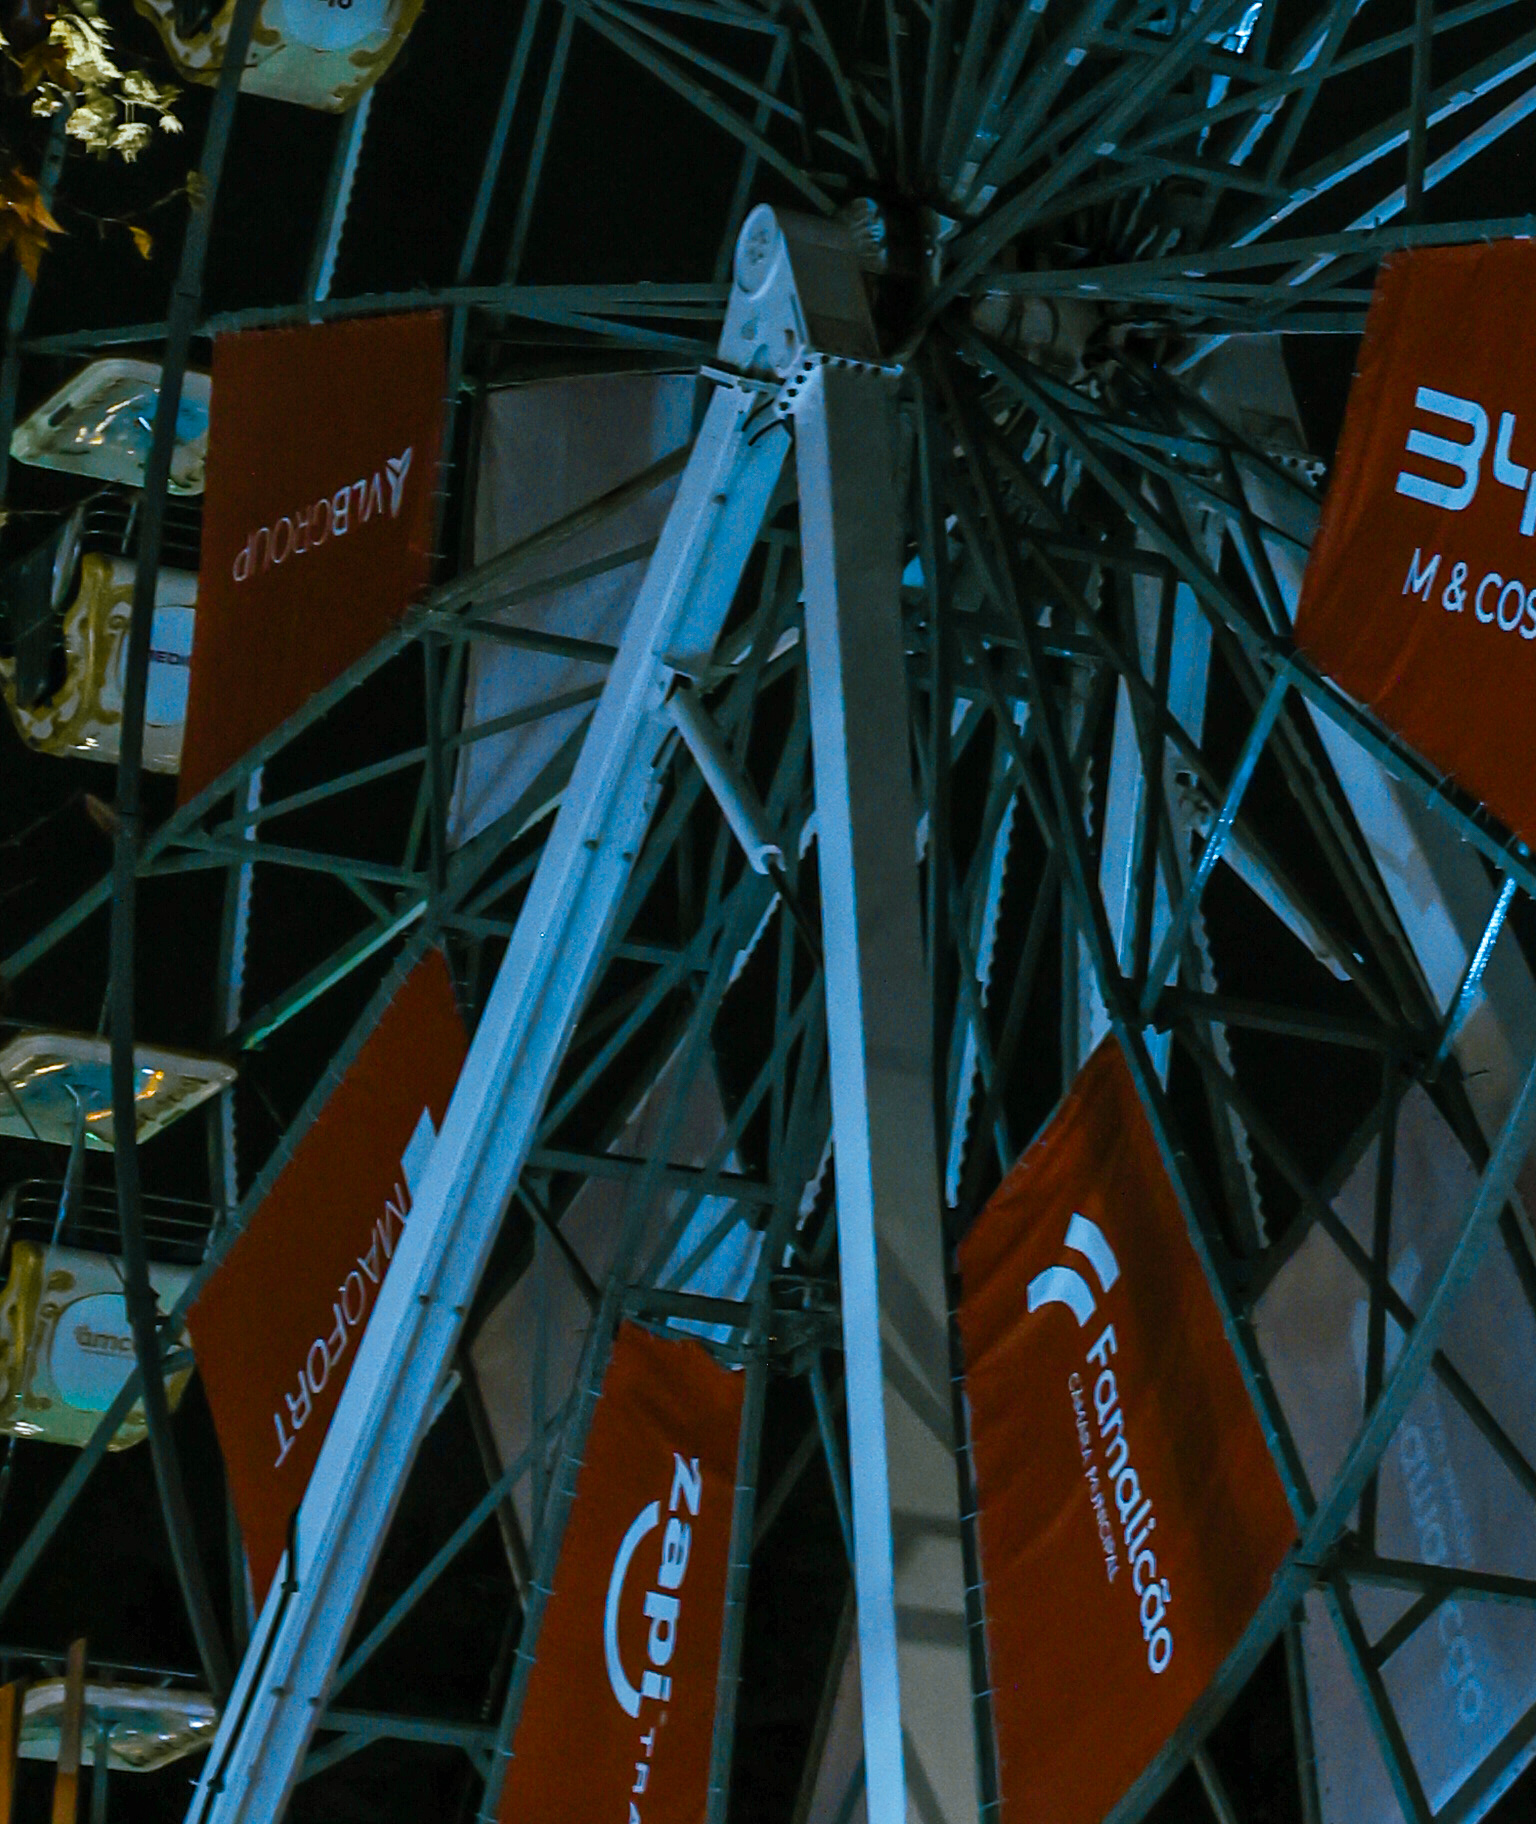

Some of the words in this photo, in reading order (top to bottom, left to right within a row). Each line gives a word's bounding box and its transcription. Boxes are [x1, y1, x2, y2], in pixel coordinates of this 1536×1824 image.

[1402, 548, 1441, 598] M
[1442, 560, 1468, 612] &
[273, 1181, 411, 1469] MAQFORT
[641, 1451, 702, 1703] zapi
[1086, 1323, 1174, 1675] Famalicão
